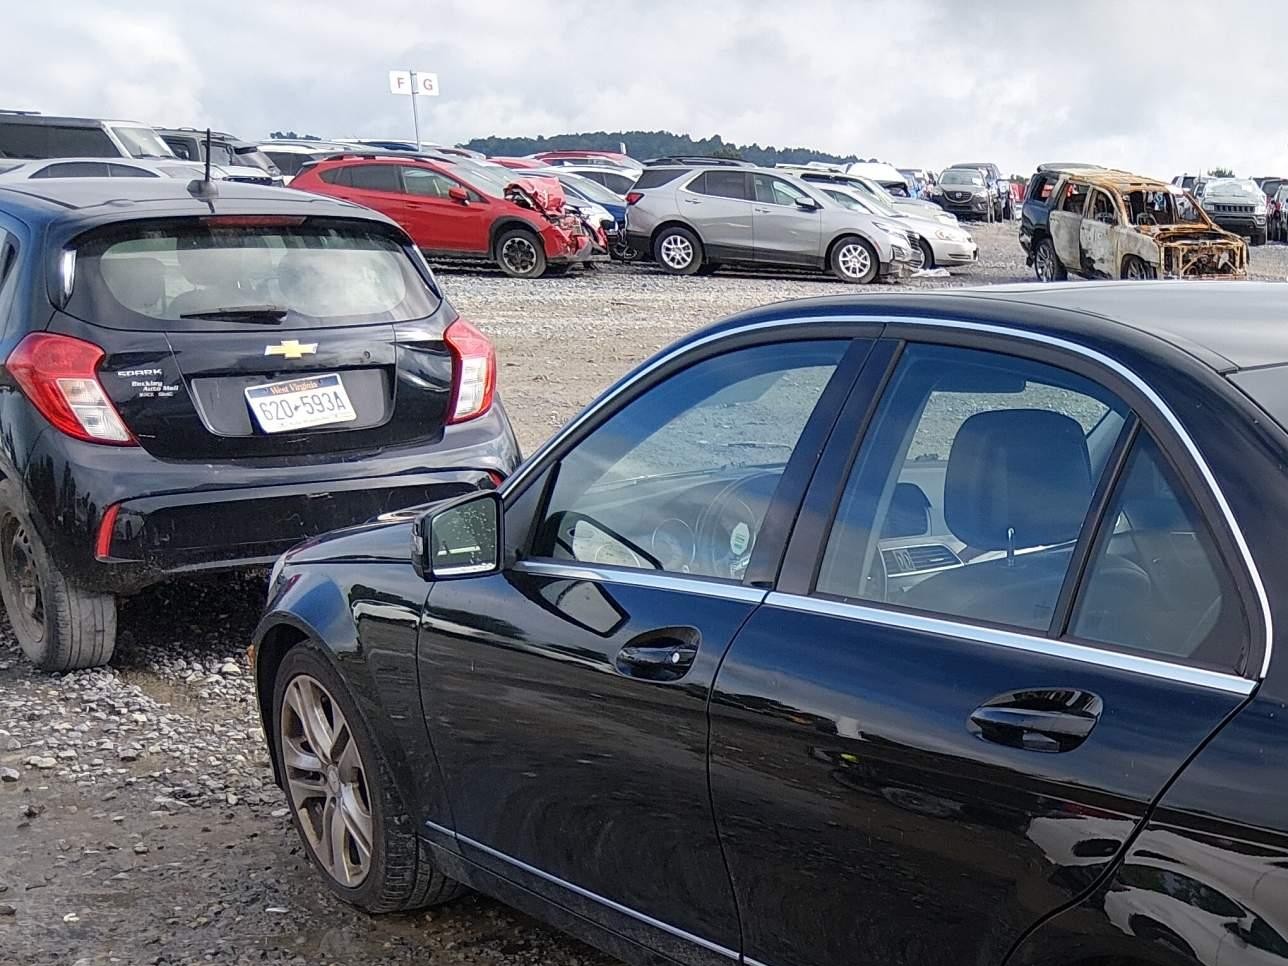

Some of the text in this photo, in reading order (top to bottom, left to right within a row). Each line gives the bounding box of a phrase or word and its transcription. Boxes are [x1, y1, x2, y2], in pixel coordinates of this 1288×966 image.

[397, 77, 405, 89] F
[423, 78, 433, 91] G
[270, 381, 319, 395] West Virginia
